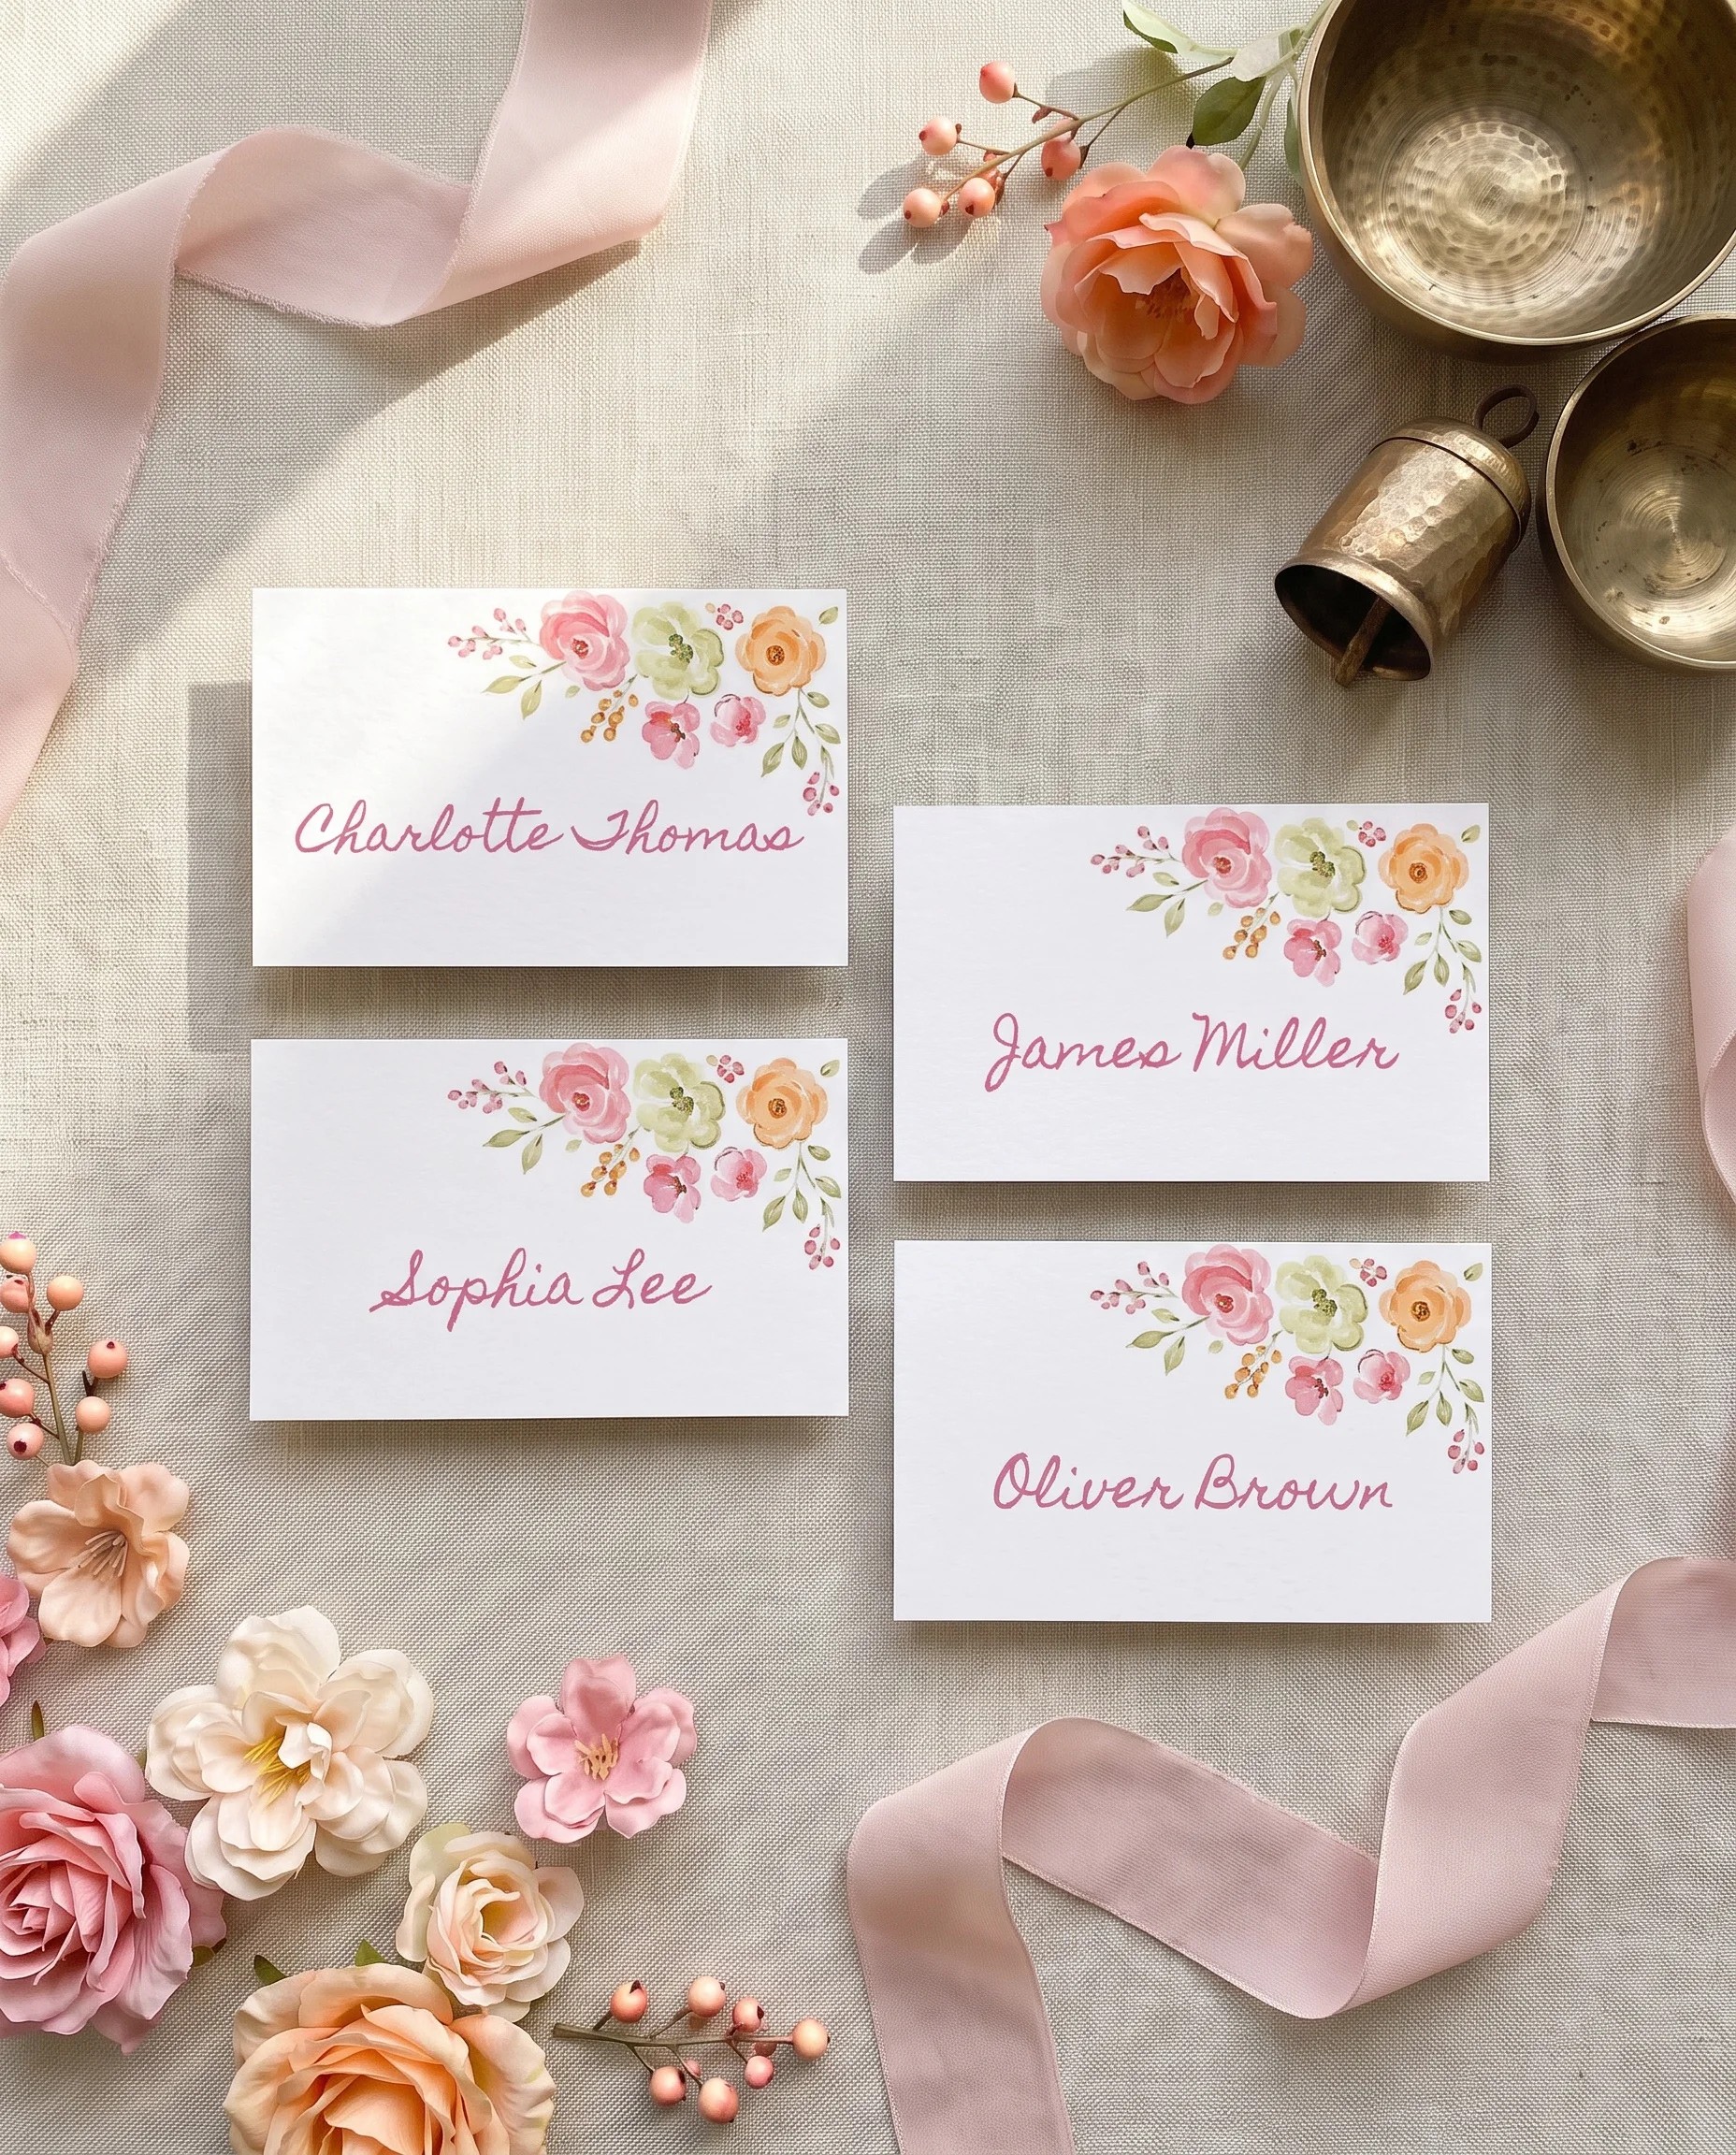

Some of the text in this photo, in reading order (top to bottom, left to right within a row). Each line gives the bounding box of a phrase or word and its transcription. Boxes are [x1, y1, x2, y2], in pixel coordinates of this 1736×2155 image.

[295, 797, 805, 856] Charlotte Thomas
[984, 1011, 1400, 1092] James Miller
[369, 1247, 713, 1333] Sophia Lee
[992, 1452, 1394, 1511] Oliver Brown
